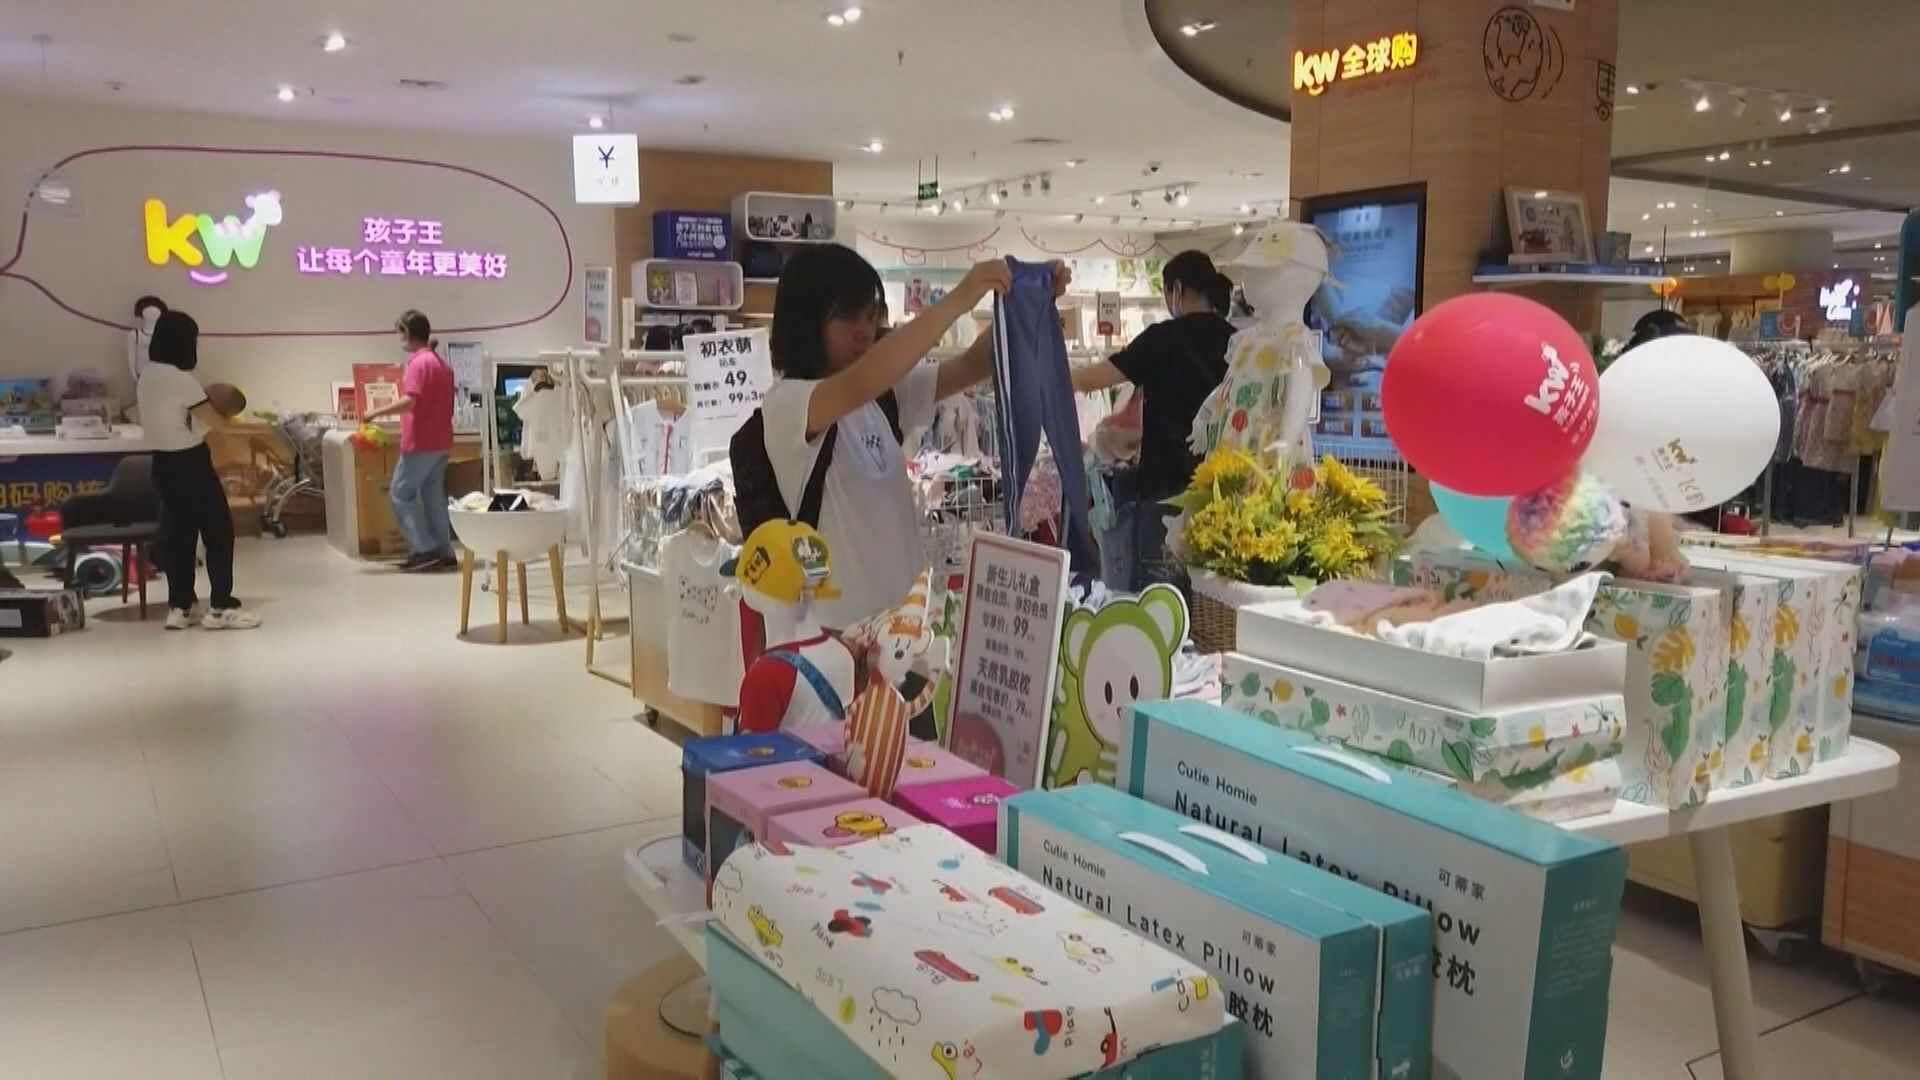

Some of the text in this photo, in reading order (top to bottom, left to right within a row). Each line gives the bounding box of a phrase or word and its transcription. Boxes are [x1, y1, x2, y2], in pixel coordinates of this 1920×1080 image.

[1341, 32, 1418, 79] 全球购
[363, 217, 444, 245] 孩子王
[297, 246, 509, 279] 让每个童年更美好
[700, 336, 752, 358] 初衣萌
[725, 369, 747, 387] 49
[986, 564, 1041, 598] 新生儿礼盒
[1013, 614, 1029, 639] 99
[976, 655, 1032, 697] 天然乳胶枕
[1177, 759, 1258, 807] Cutie Homie
[1174, 789, 1263, 845] Natural
[1043, 839, 1107, 879] Cutie Homie
[1042, 865, 1275, 995] Natural Latex Pillow
